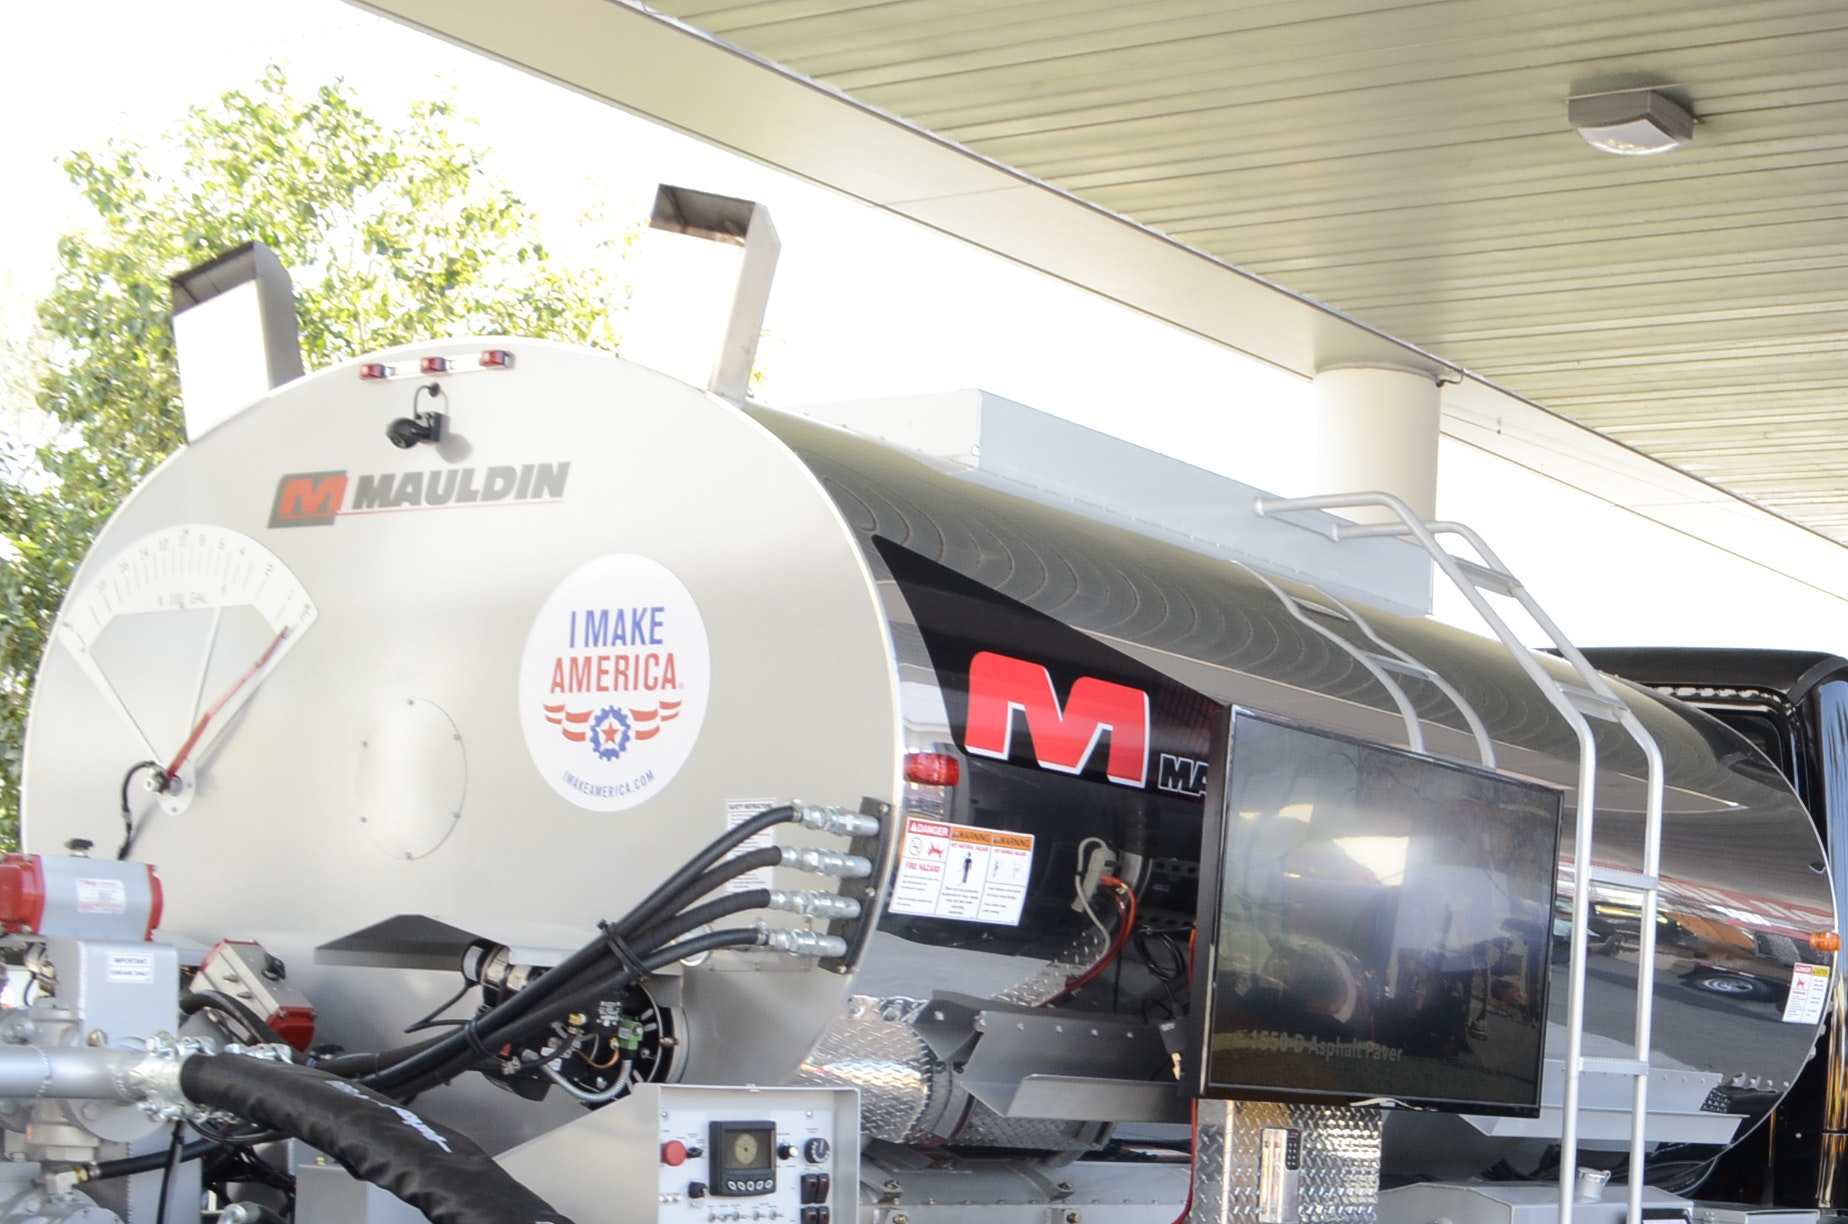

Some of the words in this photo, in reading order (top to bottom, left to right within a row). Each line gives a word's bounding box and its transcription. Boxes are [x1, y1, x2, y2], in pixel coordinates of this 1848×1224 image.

[352, 461, 571, 511] MAULDIN
[569, 610, 577, 649] I
[584, 606, 665, 648] MAKE
[550, 652, 678, 694] AMERICA
[964, 650, 1150, 789] M
[561, 769, 656, 798] IMAKEAMERICA.COM
[916, 823, 949, 837] DANGER
[1308, 1034, 1362, 1062] Asphalt
[1365, 1039, 1403, 1062] Paver
